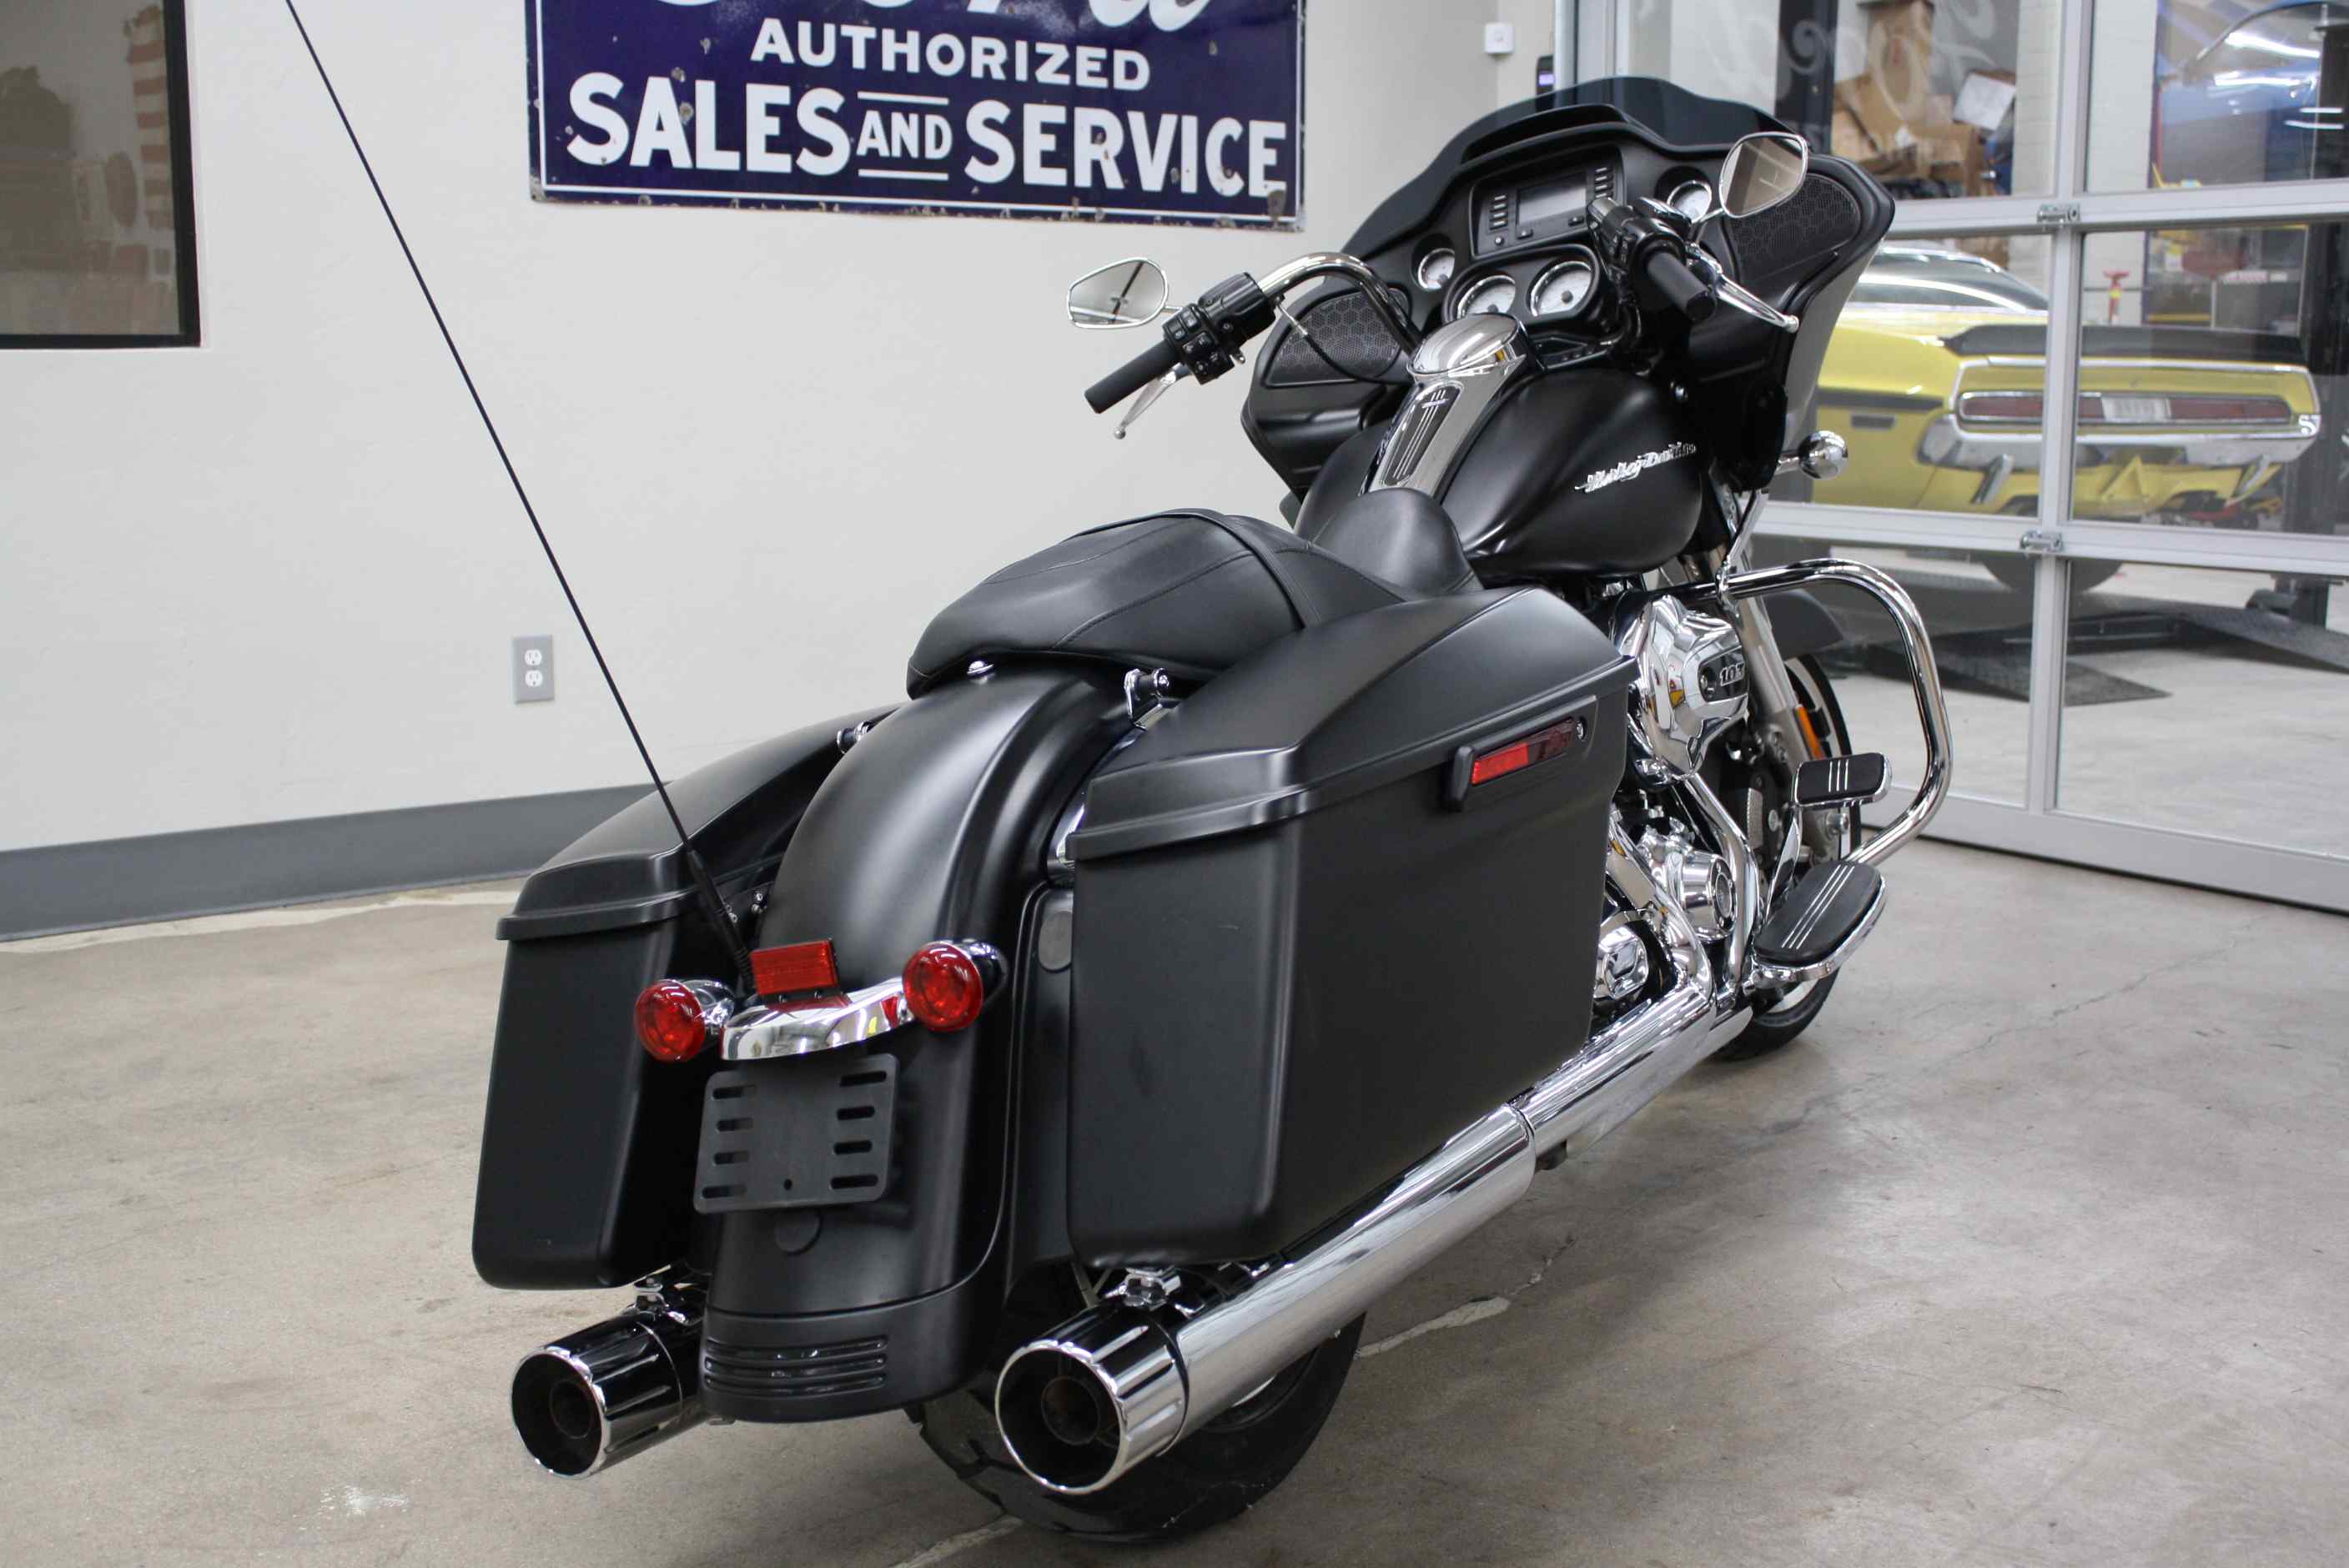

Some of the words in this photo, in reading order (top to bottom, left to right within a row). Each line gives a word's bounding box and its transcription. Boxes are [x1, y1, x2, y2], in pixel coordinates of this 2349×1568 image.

[751, 18, 1150, 91] AUTHORIZED
[566, 72, 852, 176] SALES
[856, 110, 953, 159] AND
[964, 99, 1287, 198] SERVICE
